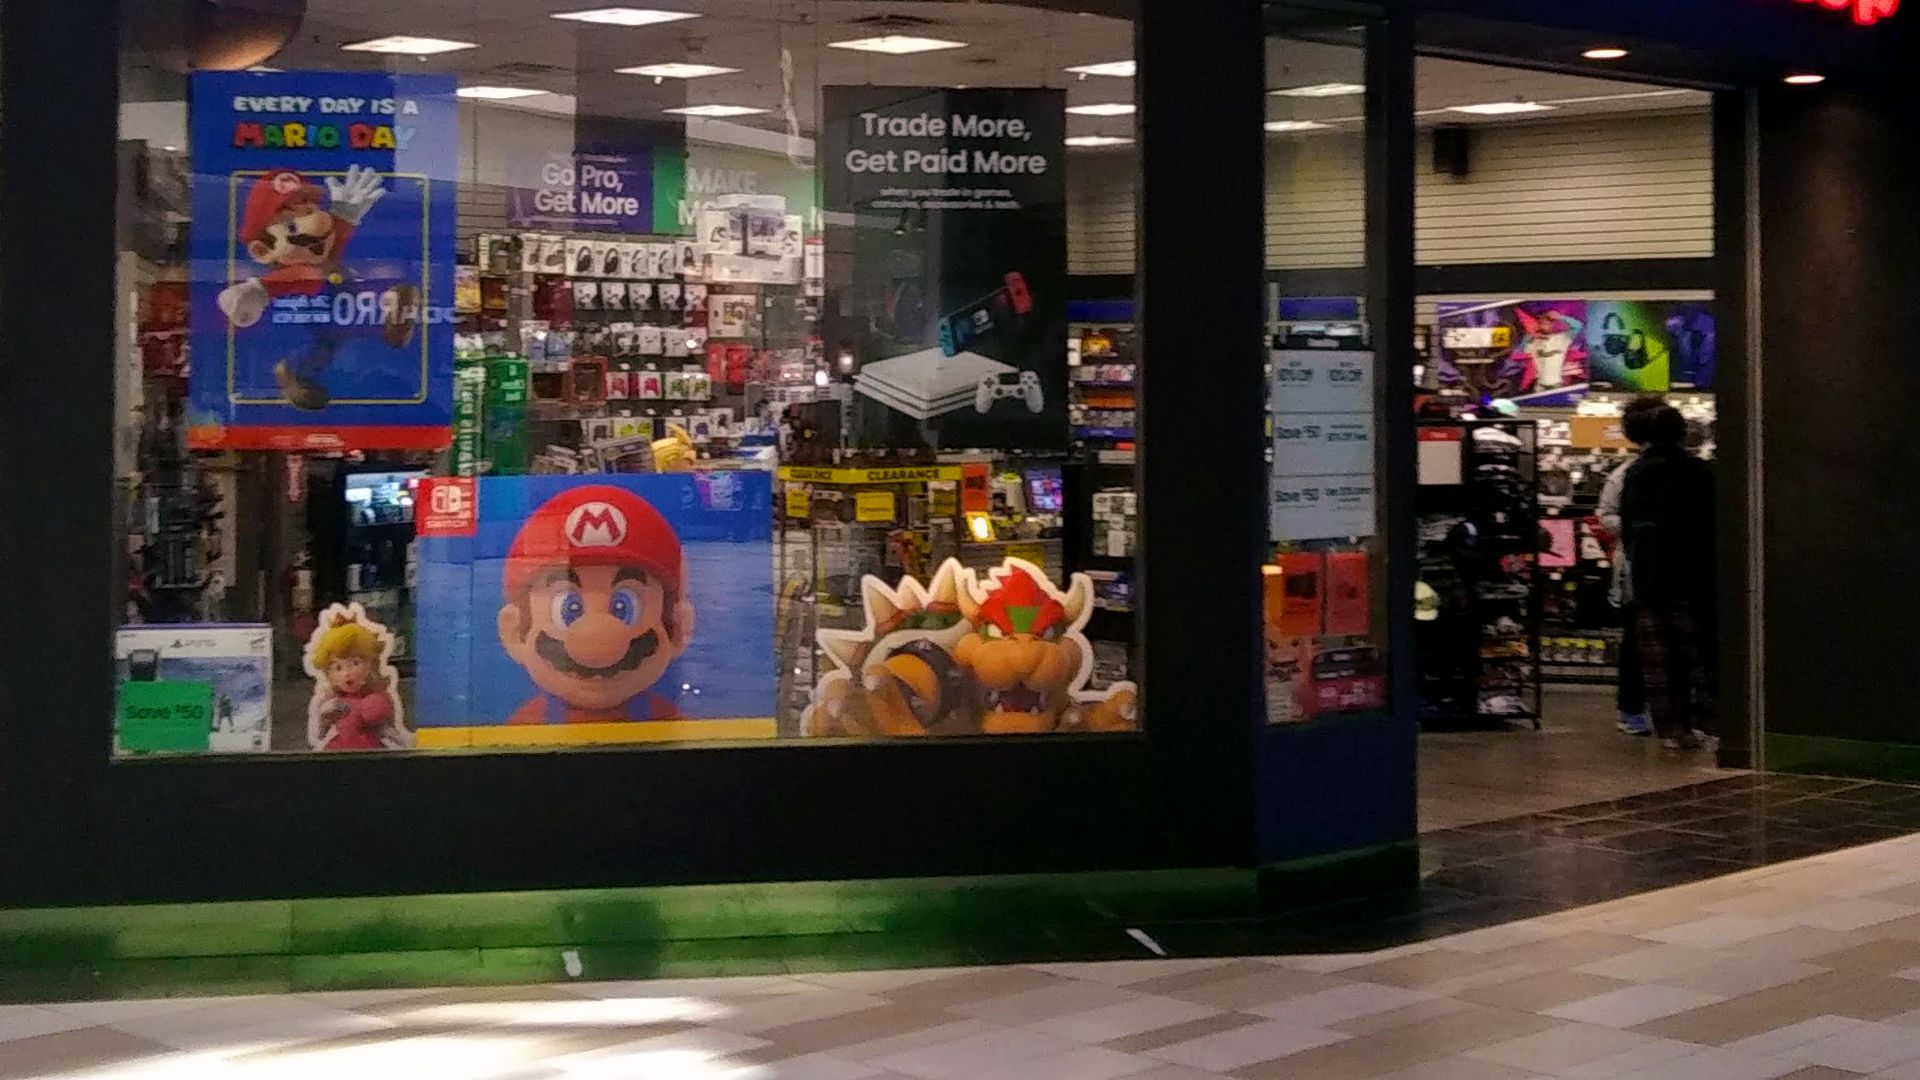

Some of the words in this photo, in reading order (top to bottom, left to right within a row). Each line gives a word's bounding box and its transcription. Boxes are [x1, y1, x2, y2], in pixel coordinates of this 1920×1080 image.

[233, 95, 312, 113] EVERY
[319, 96, 366, 114] DAY
[370, 98, 395, 114] IS
[402, 99, 419, 115] A
[233, 122, 340, 148] MARIO
[349, 123, 416, 150] DAY
[860, 113, 946, 137] Trade
[952, 114, 1032, 142] More,
[845, 149, 898, 173] Get
[903, 148, 967, 173] Paid
[974, 151, 1048, 174] More
[542, 163, 575, 187] Go
[581, 164, 624, 192] Pro,
[535, 189, 576, 213] Get
[581, 192, 640, 216] More
[867, 469, 940, 481] CLEARANCE
[125, 703, 171, 720] Save
